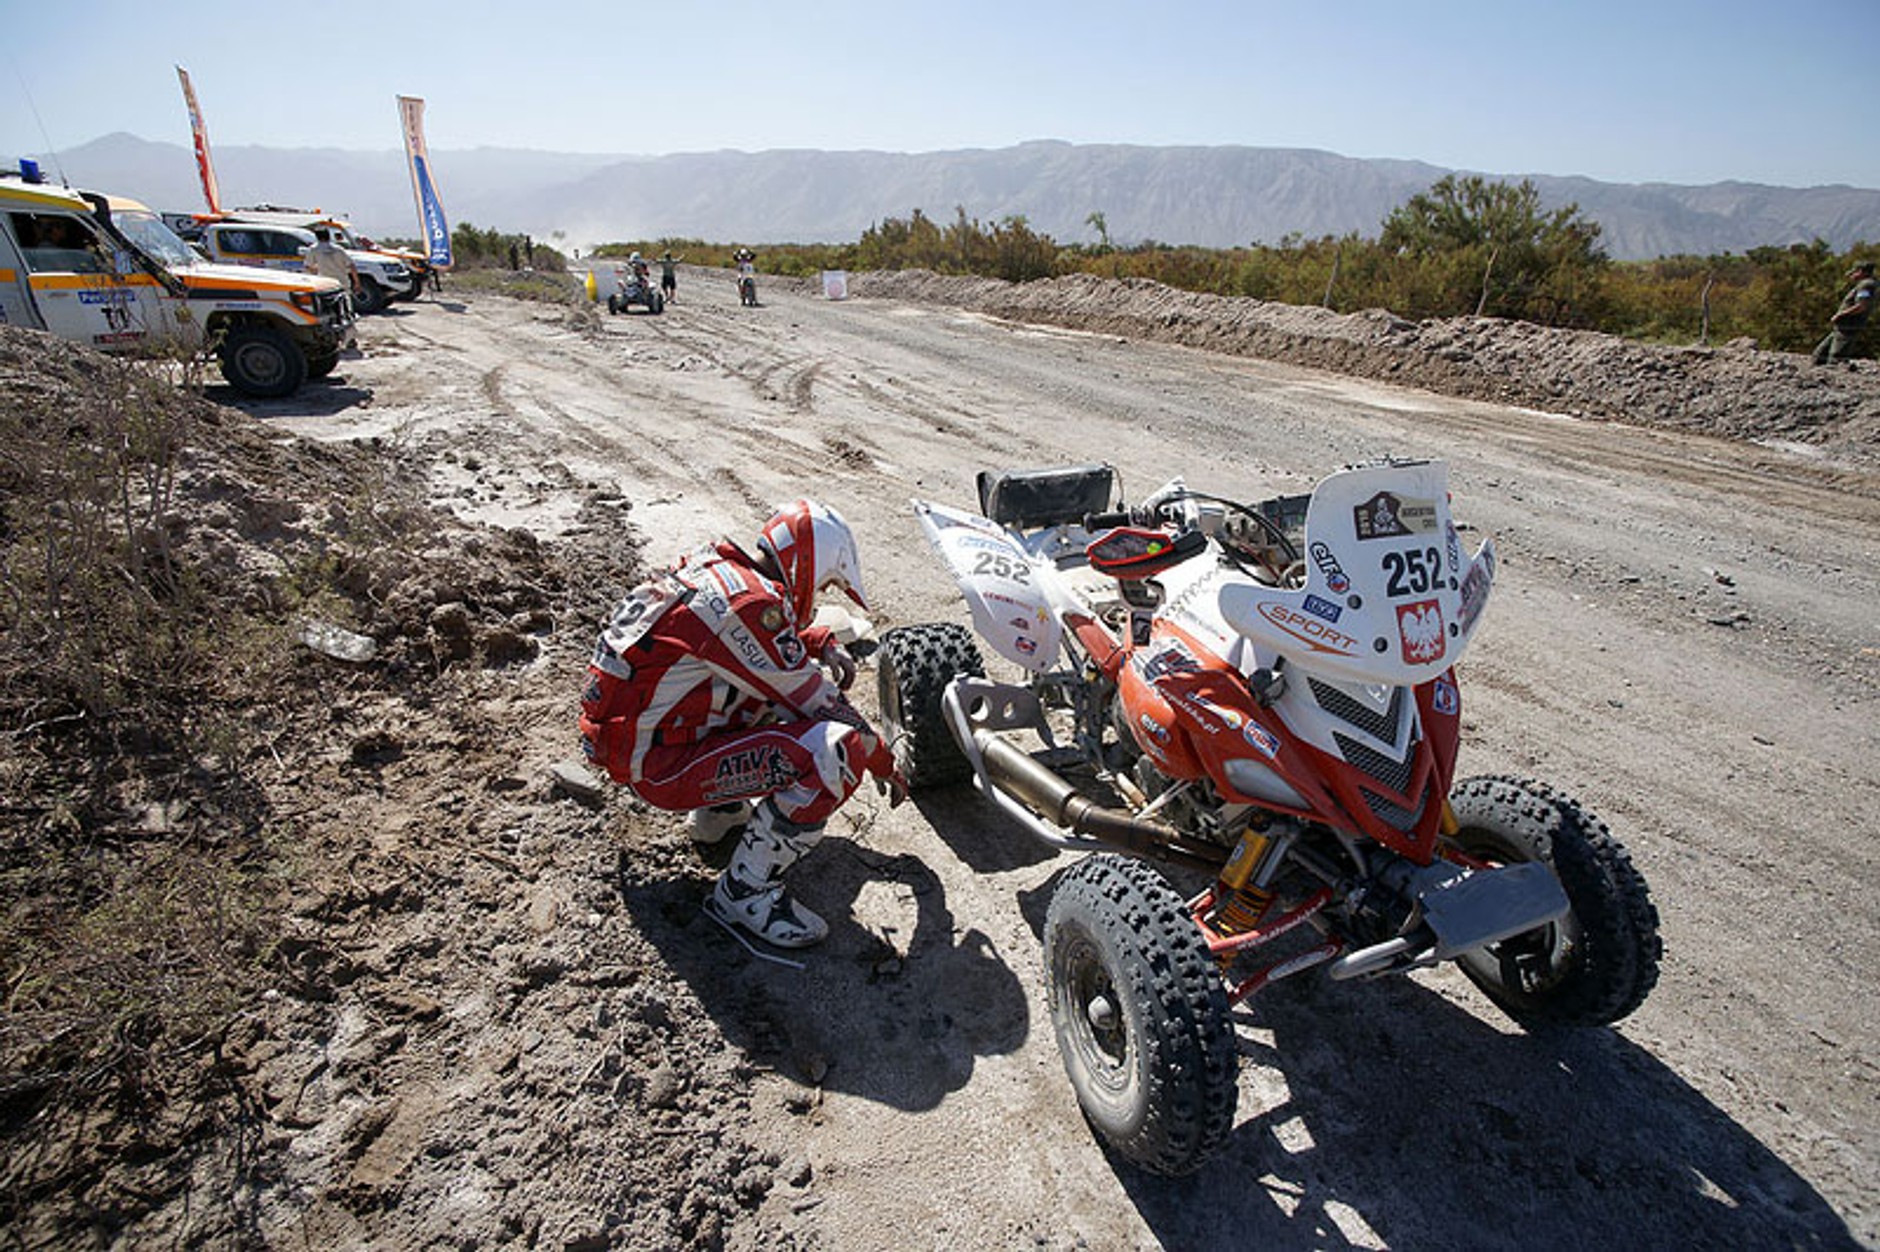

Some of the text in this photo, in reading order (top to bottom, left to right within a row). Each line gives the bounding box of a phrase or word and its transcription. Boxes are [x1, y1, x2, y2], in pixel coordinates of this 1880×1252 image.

[973, 550, 1032, 587] 252
[1381, 546, 1446, 597] 252
[1270, 604, 1358, 650] SPORT
